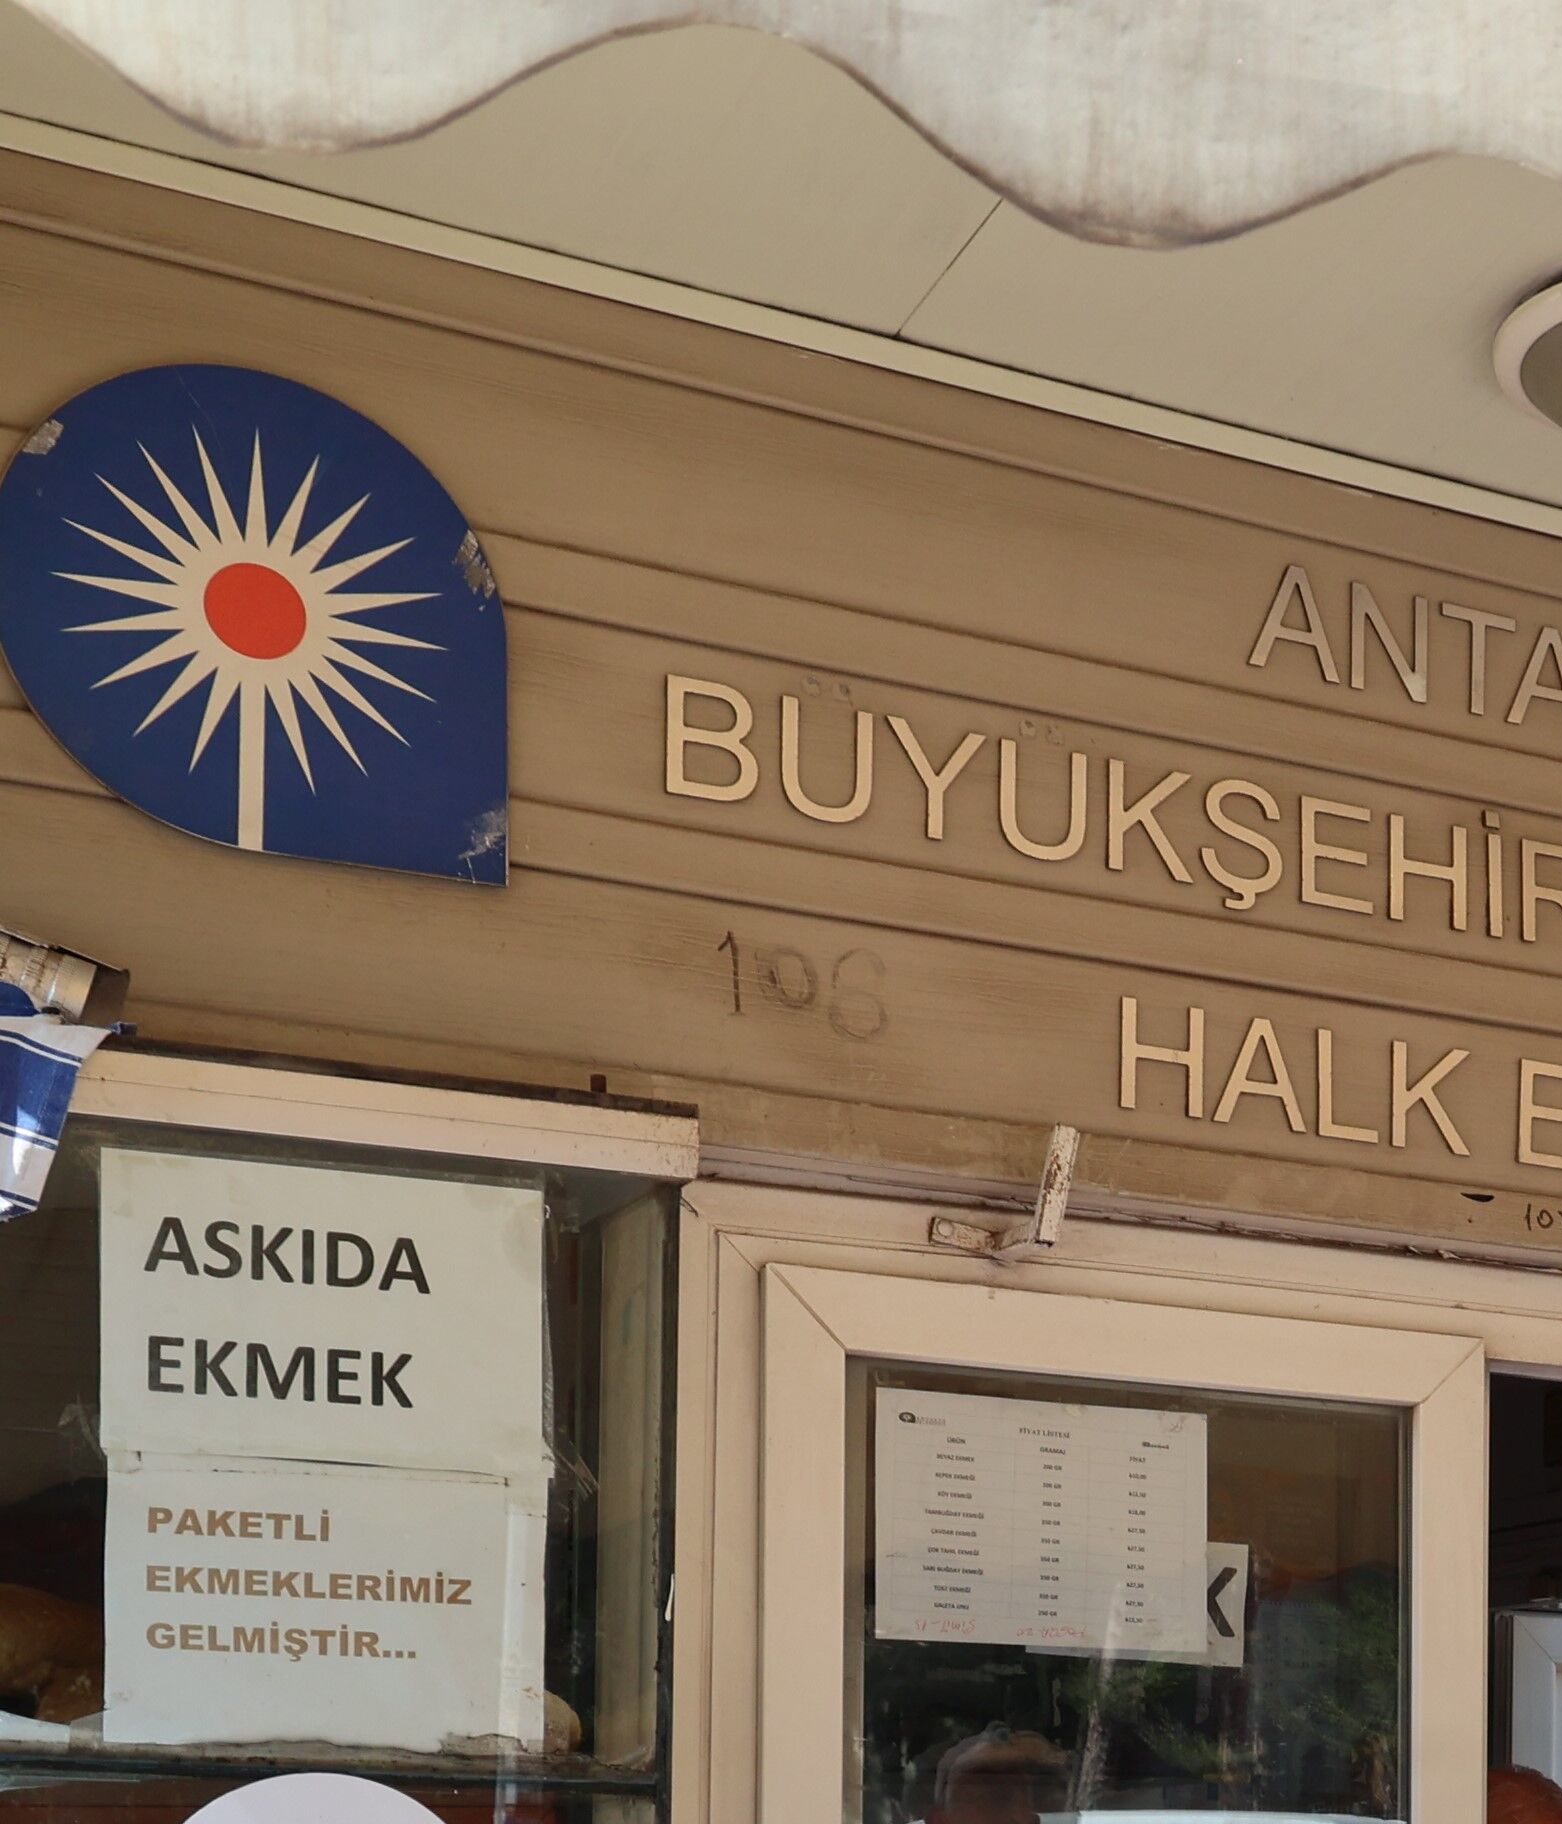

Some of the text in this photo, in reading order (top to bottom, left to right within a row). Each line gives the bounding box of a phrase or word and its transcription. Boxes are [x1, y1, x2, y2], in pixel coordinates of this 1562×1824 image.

[1119, 996, 1471, 1156] HALK
[143, 1215, 431, 1296] ASKIDA
[146, 1335, 414, 1409] EKMEK
[146, 1506, 331, 1543] PAKETLİ
[146, 1564, 473, 1607] EKMEKLERİMİZ
